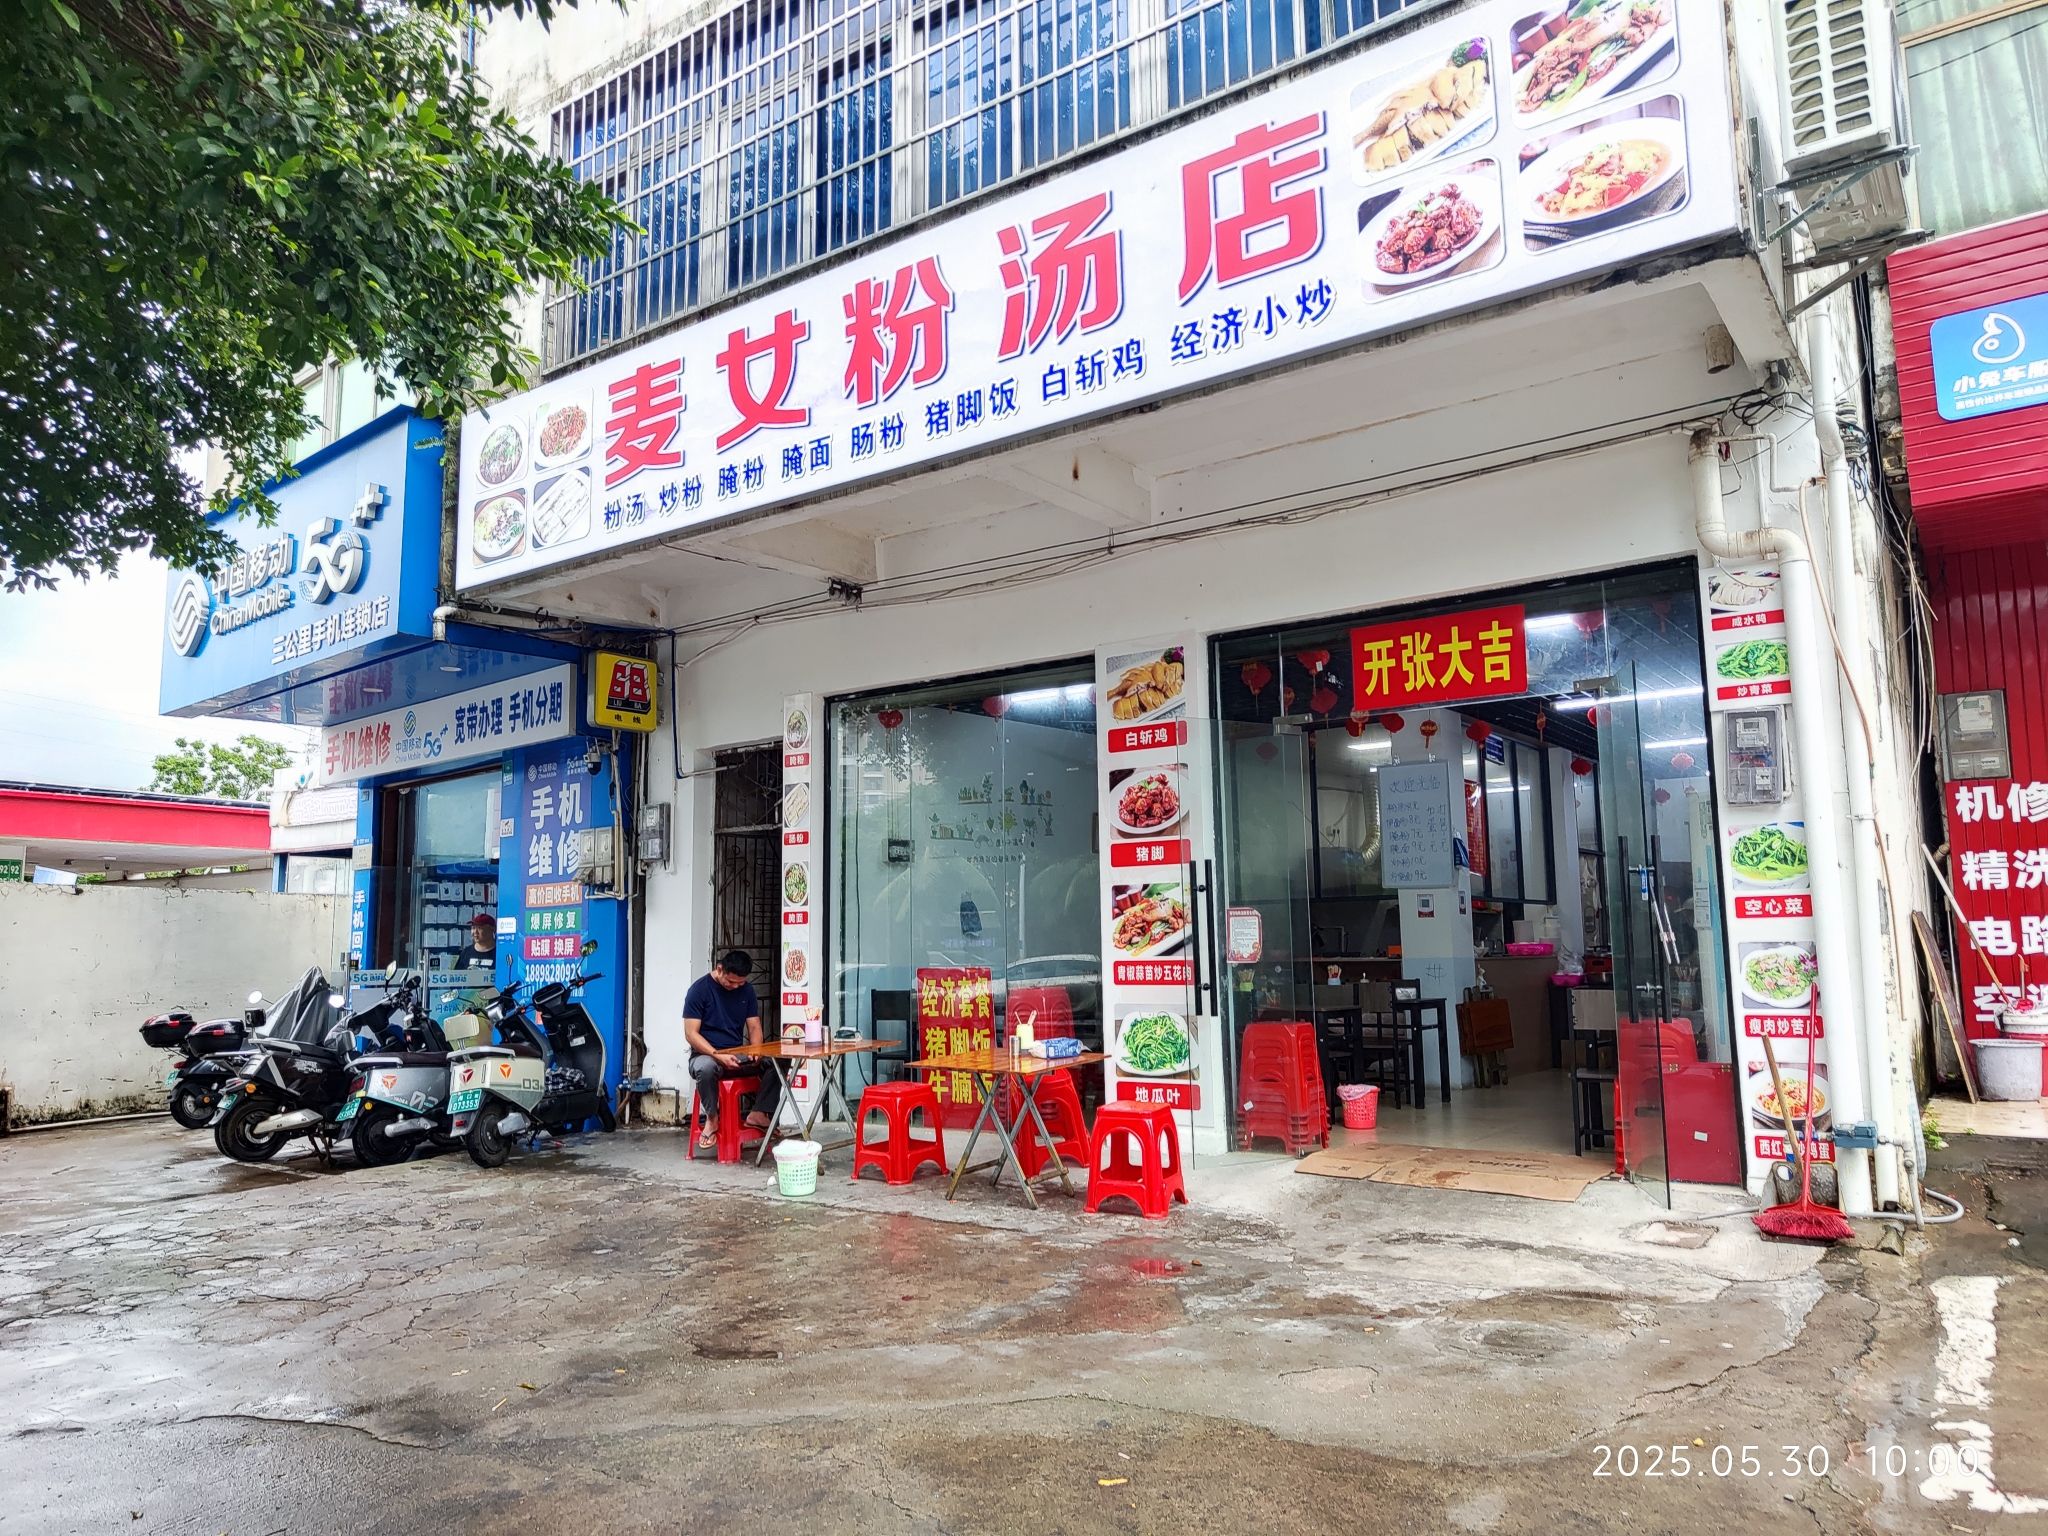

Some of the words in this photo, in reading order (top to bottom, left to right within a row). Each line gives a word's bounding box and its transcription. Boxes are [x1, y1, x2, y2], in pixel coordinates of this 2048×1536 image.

[605, 112, 1327, 487] 麦女粉汤店
[603, 493, 644, 530] 粉汤
[658, 474, 702, 514] 炒粉
[717, 455, 764, 497] 腌粉
[781, 435, 832, 479] 腌面
[850, 412, 904, 458] 肠粉
[925, 376, 1017, 437] 猪脚饭
[1042, 338, 1144, 401] 白斩鸡
[1170, 278, 1332, 361] 经济小炒
[211, 532, 293, 602] 中国移动
[271, 595, 390, 665] 三公里手机连锁店
[1731, 613, 1767, 628] 咸水鸭
[1363, 620, 1513, 696] 开张大吉
[608, 660, 652, 704] 68
[1736, 683, 1773, 697] 炒青菜
[454, 697, 503, 746] 宽带办理
[508, 681, 563, 734] 手机分期
[326, 721, 392, 776] 手机维修
[1125, 728, 1169, 748] 白斩鸡
[530, 782, 584, 831] 手机
[1955, 781, 2048, 824] 机修
[528, 830, 581, 879] 维修
[1136, 846, 1165, 863] 猪脚
[1959, 848, 2048, 891] 精洗
[528, 882, 580, 905] 高价回收手机
[1744, 896, 1804, 916] 空心菜
[530, 911, 577, 931] 爆屏修复
[530, 939, 551, 957] 贴膜
[554, 937, 575, 956] 换屏
[922, 976, 991, 1019] 经济套餐
[925, 1026, 991, 1059] 猪脚饭
[1135, 1086, 1181, 1105] 地瓜叶
